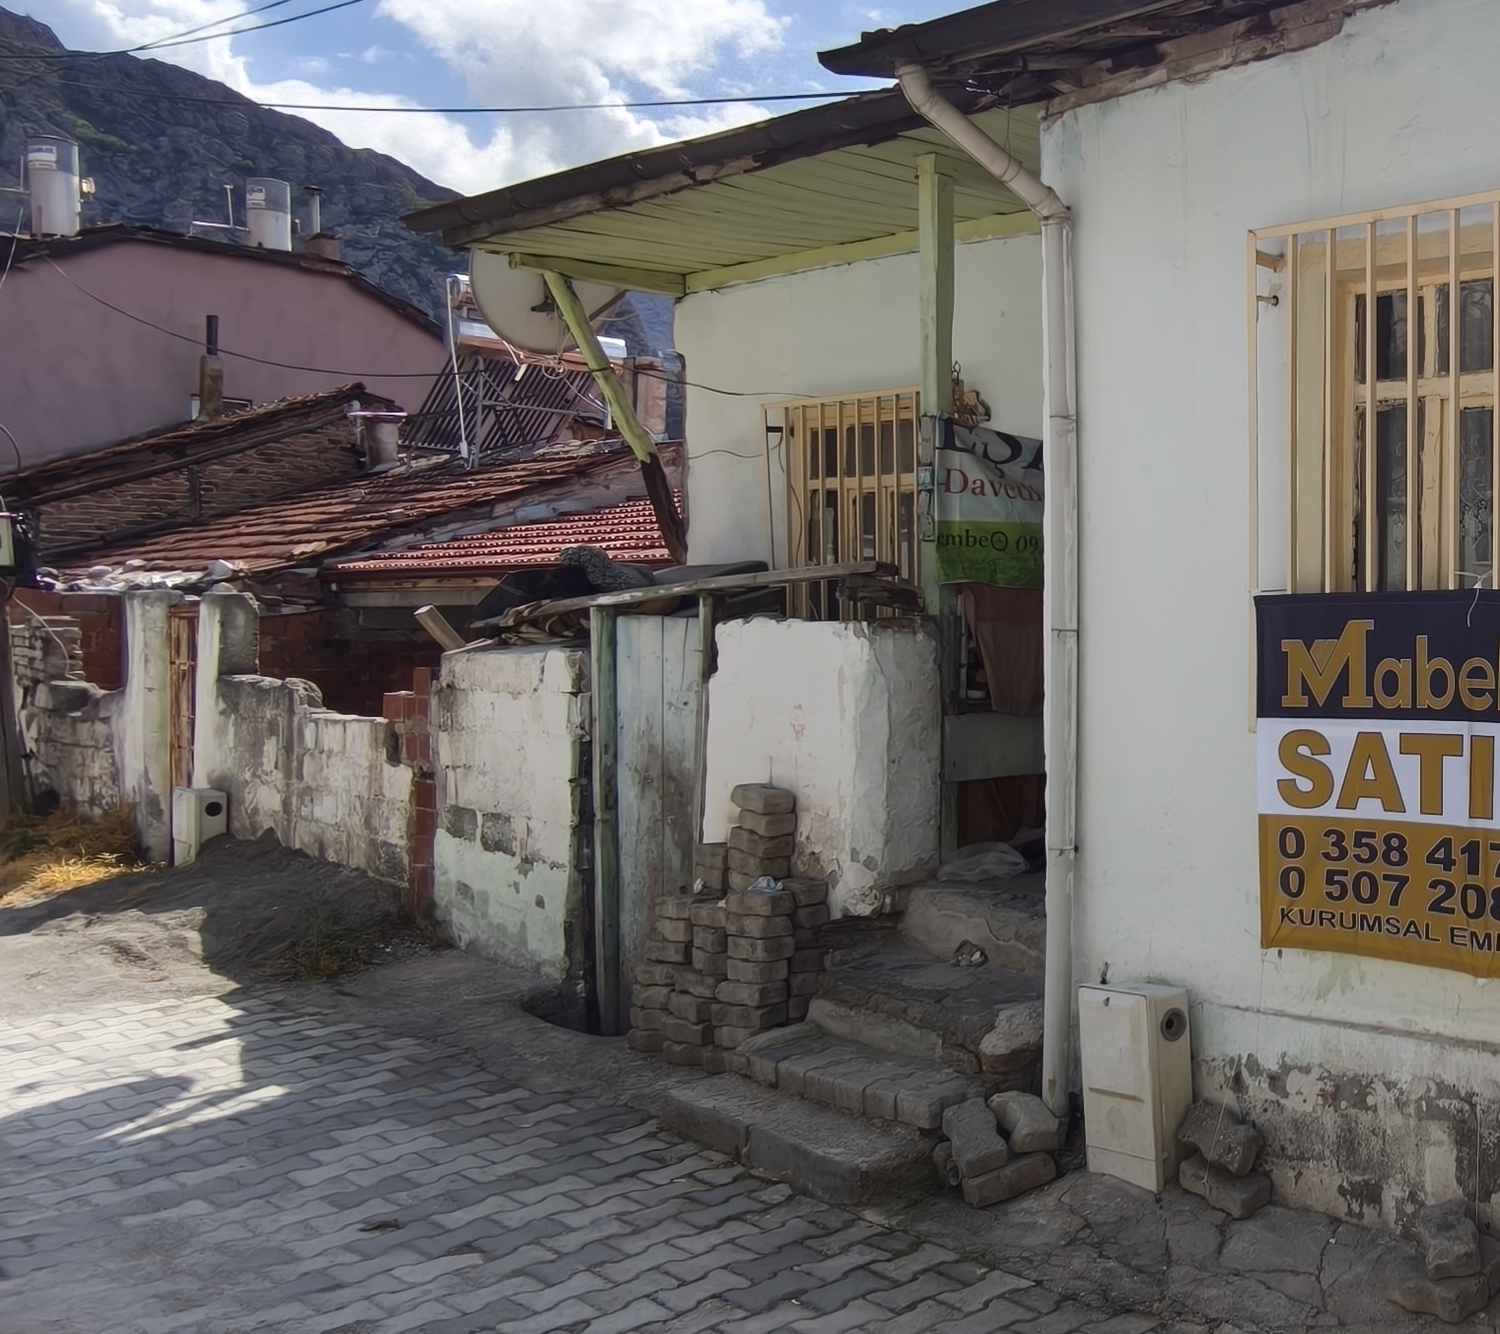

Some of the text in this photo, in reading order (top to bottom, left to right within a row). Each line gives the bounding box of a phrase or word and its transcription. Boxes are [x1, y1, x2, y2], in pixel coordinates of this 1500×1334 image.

[1278, 825, 1306, 860] 0
[1320, 827, 1409, 867] 358
[1279, 865, 1306, 899] 0
[1323, 868, 1410, 907] 507
[1279, 907, 1441, 942] KURUMSAL
